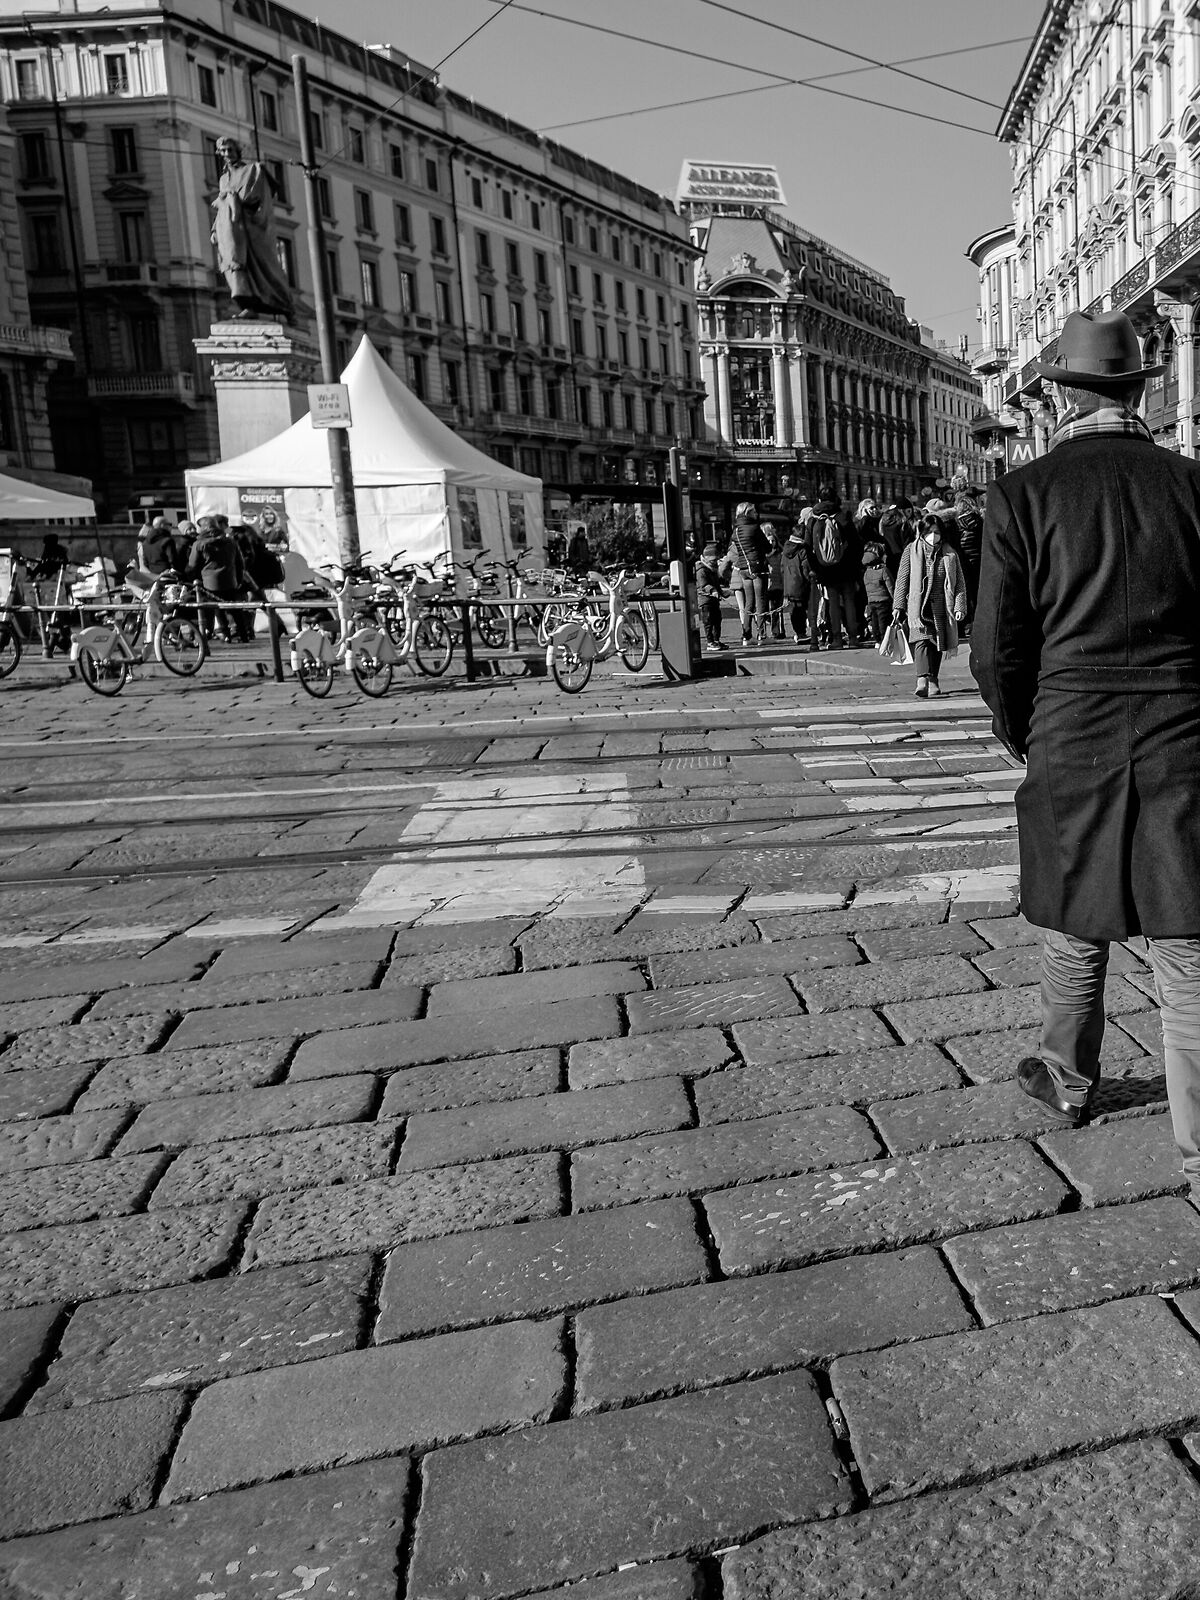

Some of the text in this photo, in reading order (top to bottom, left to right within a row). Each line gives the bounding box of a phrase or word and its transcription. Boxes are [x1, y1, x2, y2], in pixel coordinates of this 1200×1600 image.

[688, 168, 778, 187] ALLEANZA
[736, 435, 777, 446] wework
[1012, 444, 1034, 460] M
[241, 494, 283, 504] OREFICE
